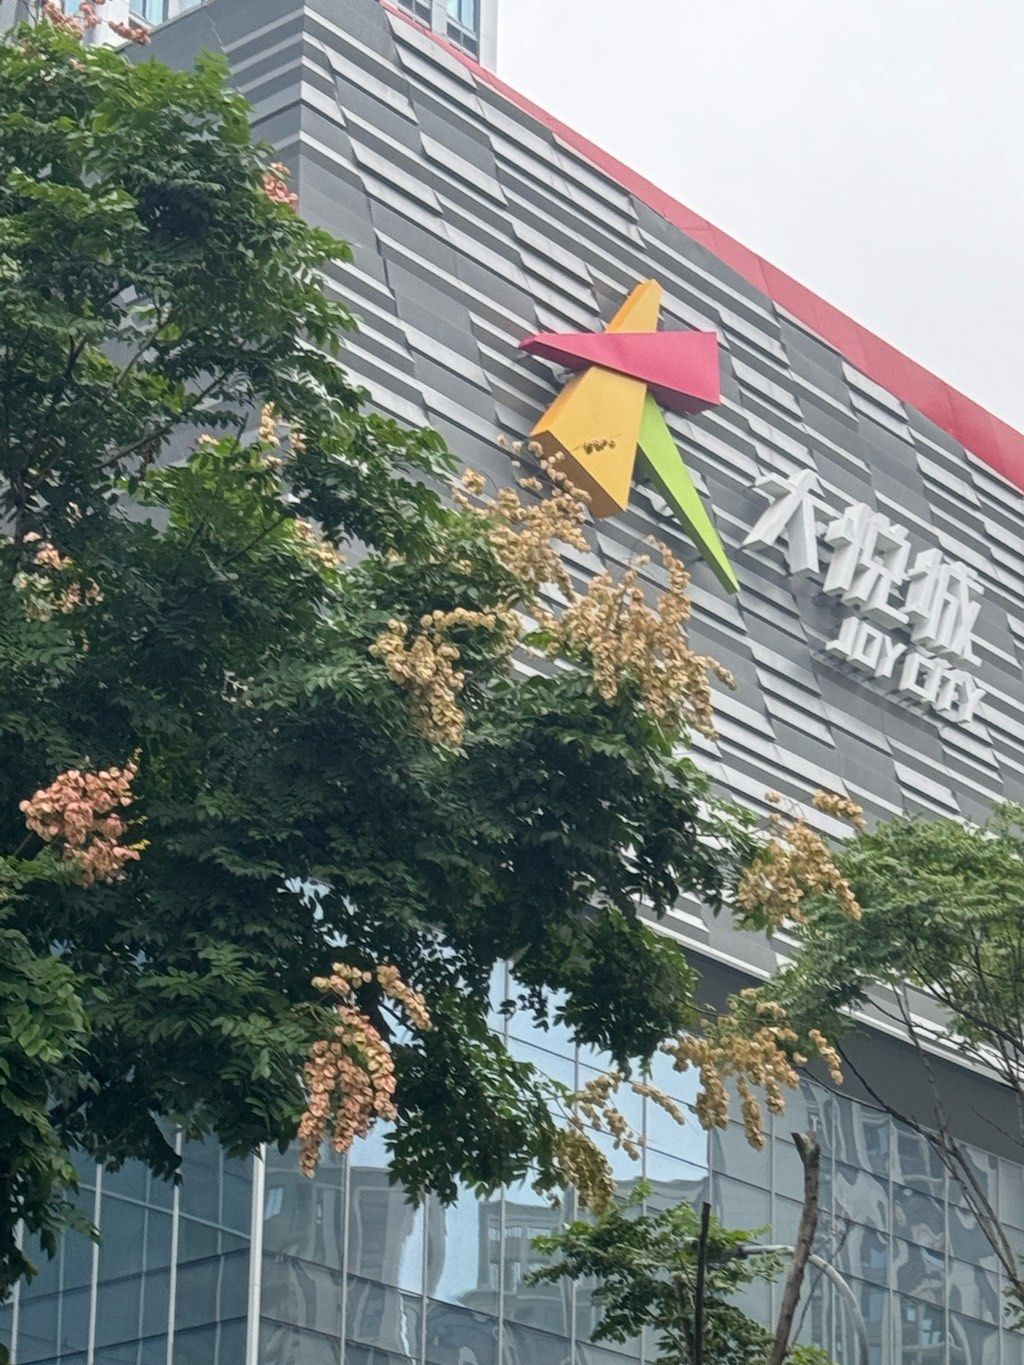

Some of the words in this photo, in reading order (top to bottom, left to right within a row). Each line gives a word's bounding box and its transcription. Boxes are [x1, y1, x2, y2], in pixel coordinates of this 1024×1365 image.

[740, 469, 984, 667] 大悦城
[825, 616, 907, 678] JOY
